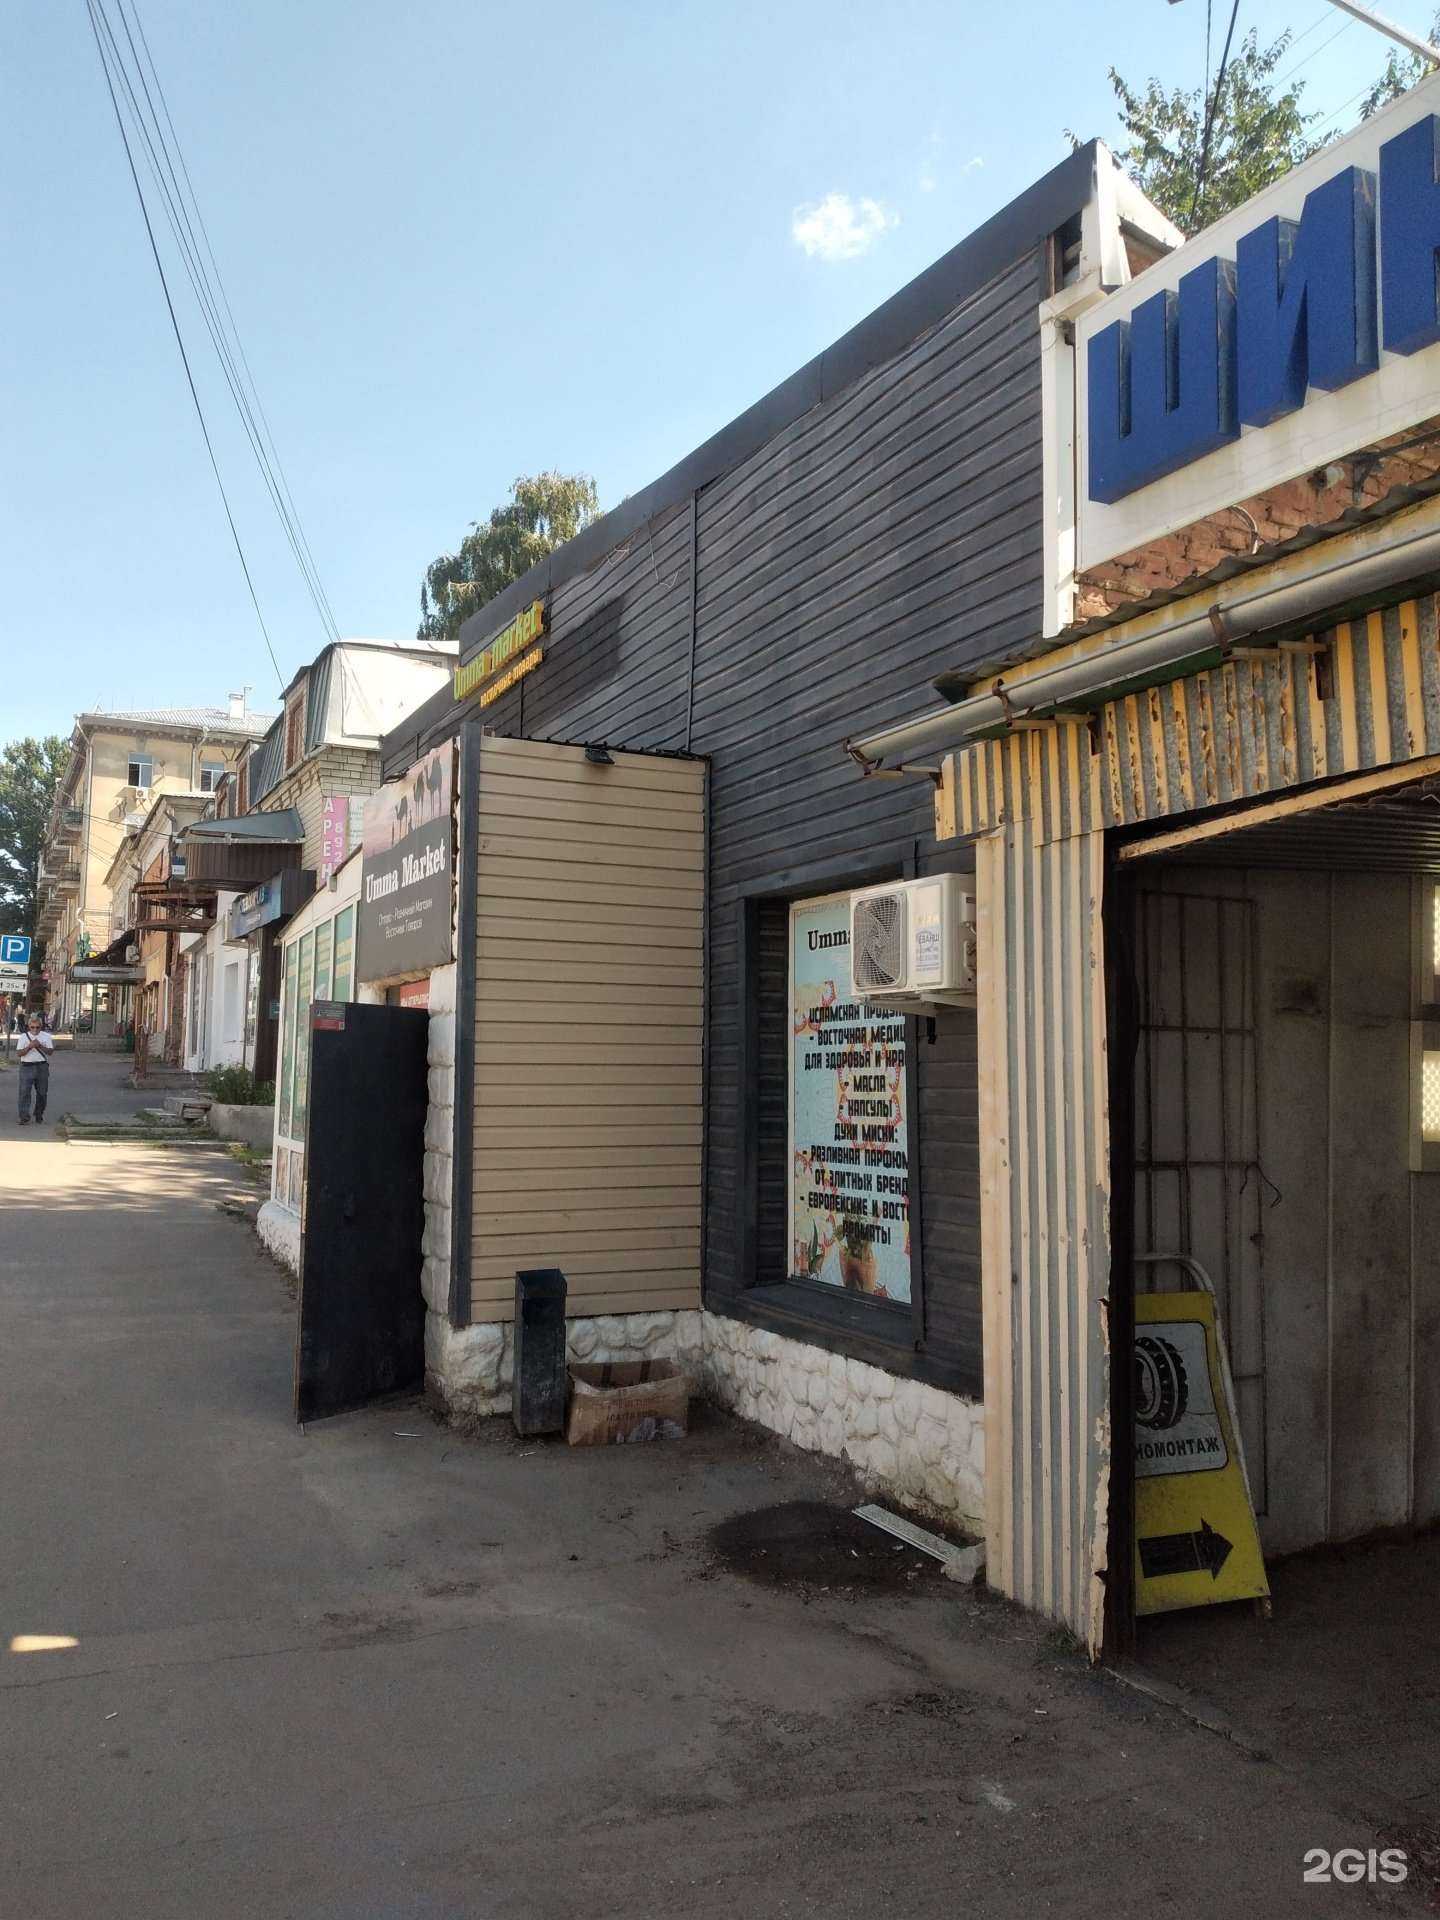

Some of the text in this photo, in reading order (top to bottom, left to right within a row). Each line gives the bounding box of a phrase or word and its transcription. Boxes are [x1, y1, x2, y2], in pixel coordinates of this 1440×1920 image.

[366, 838, 446, 903] Umma Market
[7, 939, 25, 960] P
[818, 1026, 867, 1046] ВОСТОЧНАЯ
[805, 1048, 905, 1071] ДЛЯ ЗДОРОВЬЯ И КРА
[853, 1074, 886, 1093] МАСЛА
[848, 1099, 893, 1118] КАПСУЛЫ
[834, 1122, 899, 1144] ДУХИ МИСКИ:
[811, 1144, 860, 1166] РАЗЛИВНАЯ
[815, 1168, 908, 1197] ОТ ЭЛИТНЫХ БРЕНД
[808, 1191, 868, 1217] ЕВРОПЕЙСКИЕ
[872, 1198, 880, 1218] И
[842, 1219, 891, 1246] АРОМАТЫ
